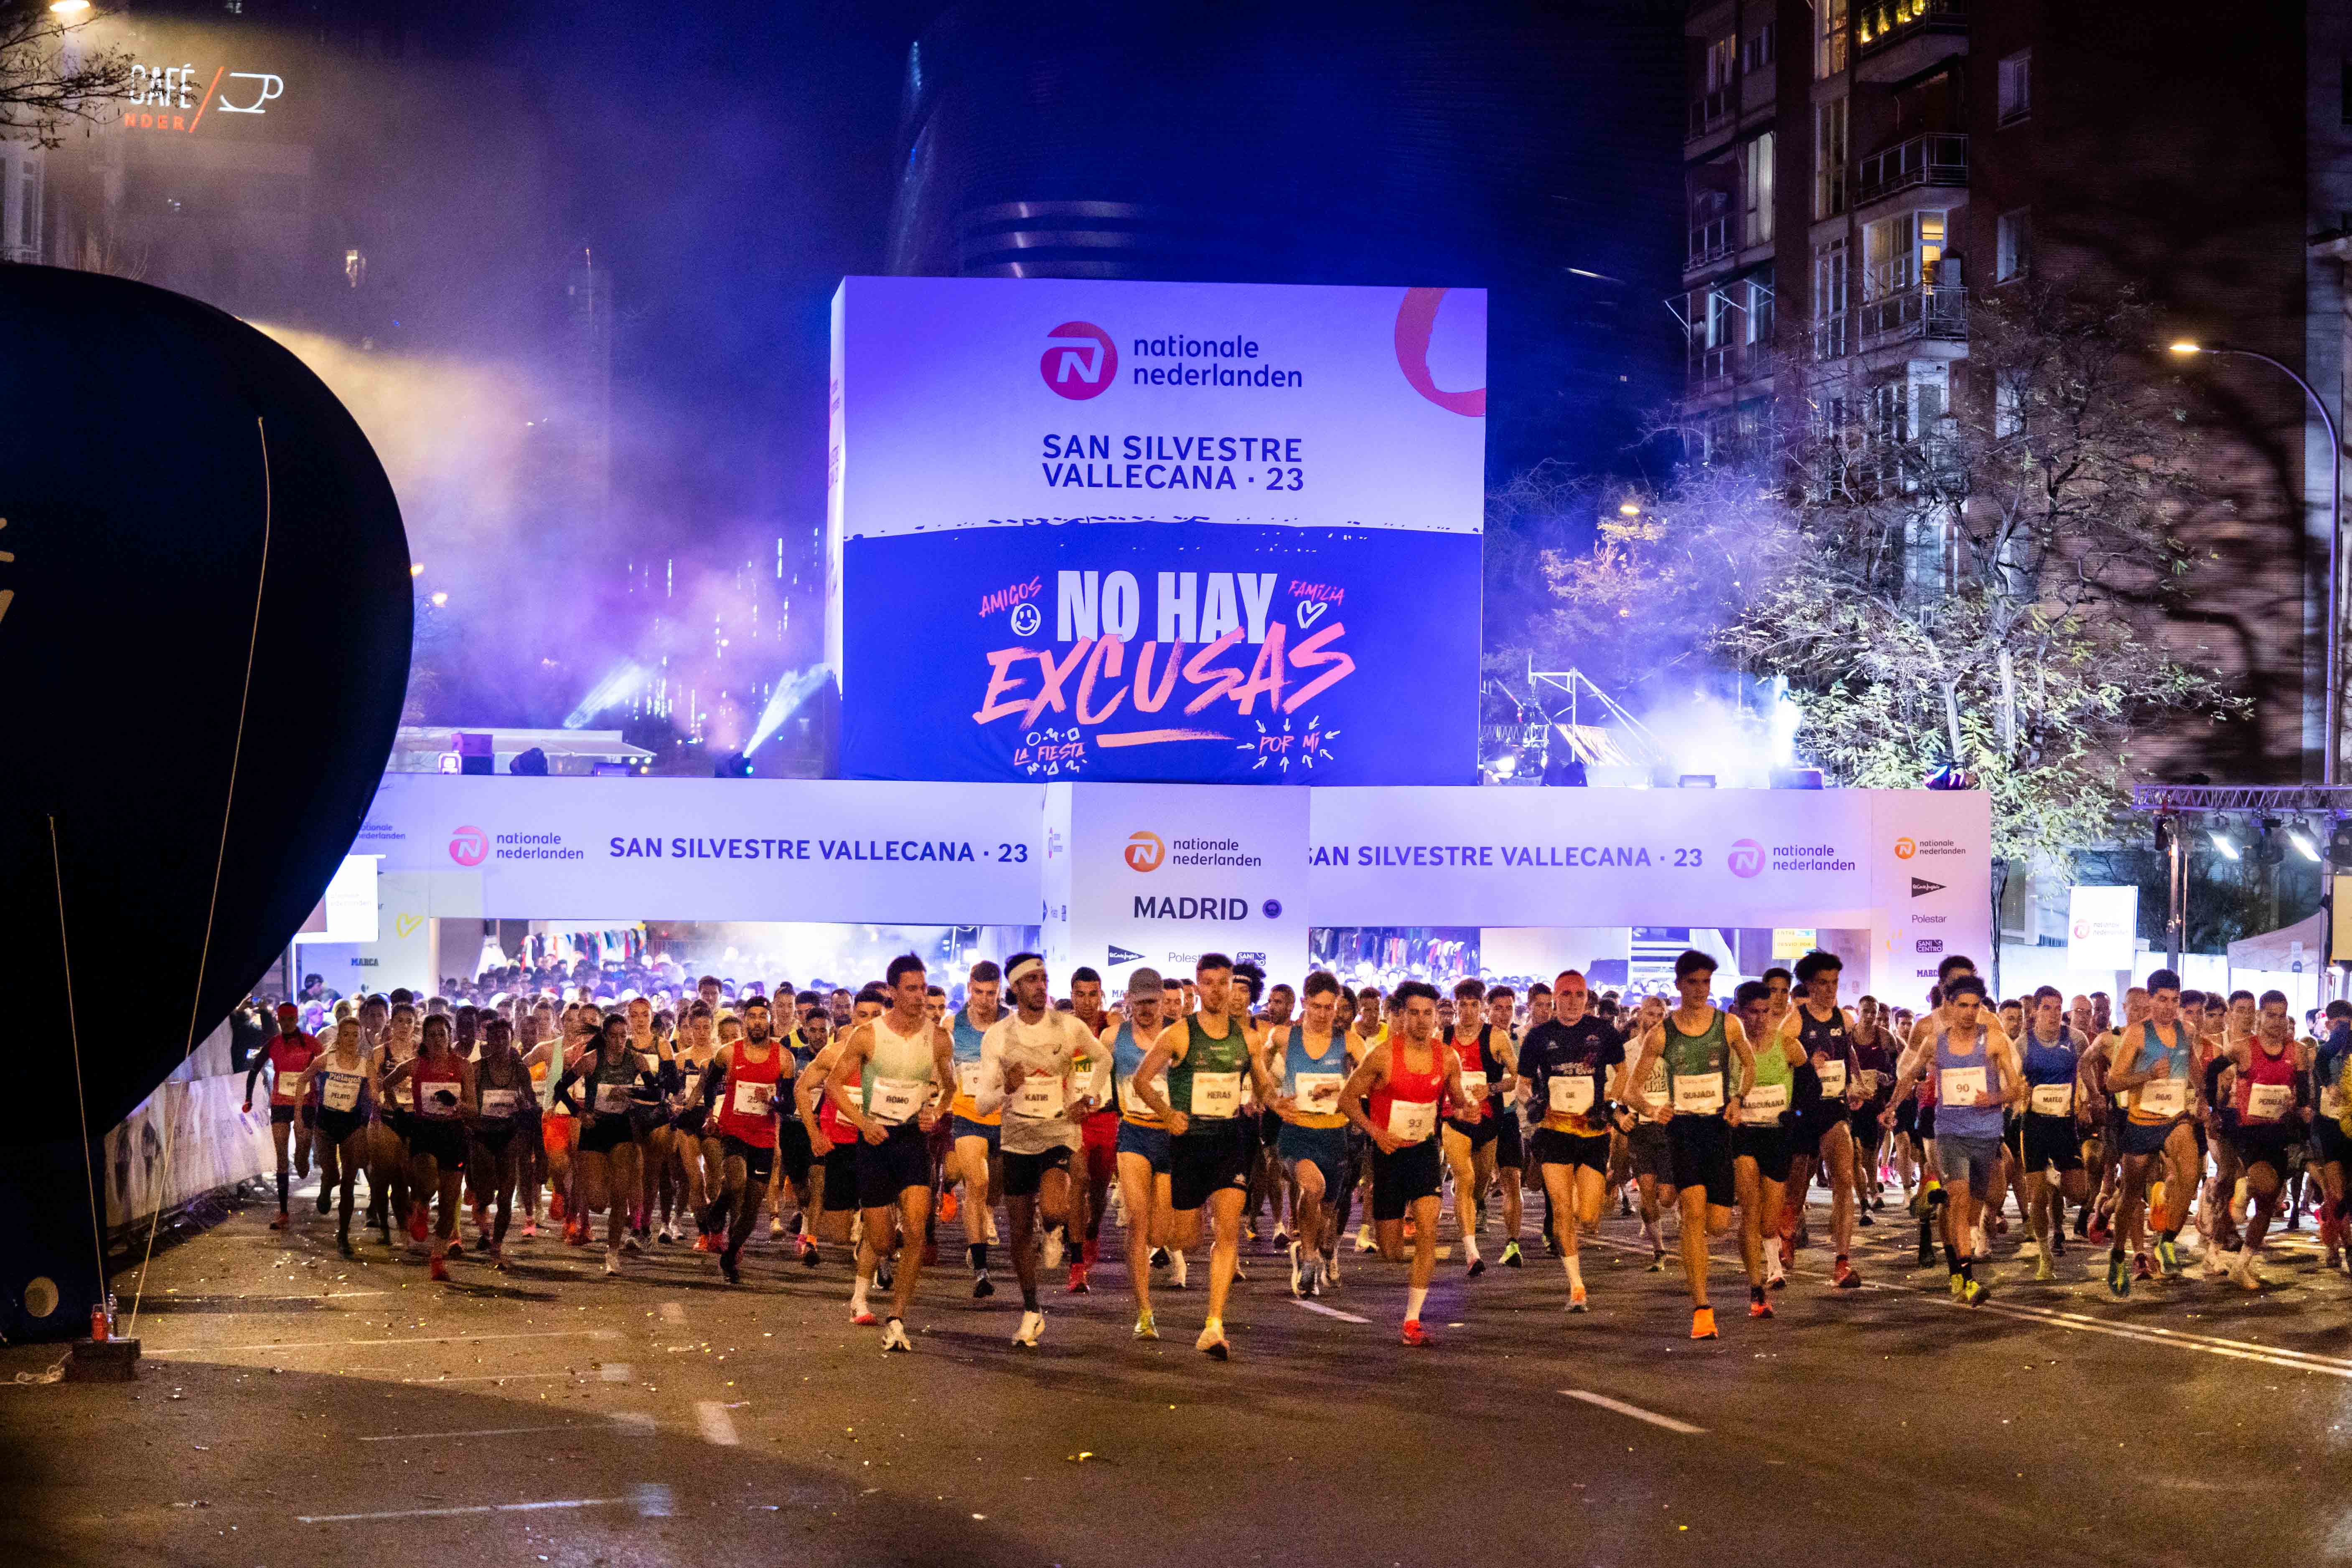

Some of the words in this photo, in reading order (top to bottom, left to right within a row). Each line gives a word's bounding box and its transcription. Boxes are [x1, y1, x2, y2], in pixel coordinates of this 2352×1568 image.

[129, 63, 195, 109] CAFÉ
[1134, 335, 1259, 358] nationale
[1134, 363, 1302, 388] nederlanden
[1043, 434, 1109, 459] SAN
[1123, 435, 1302, 462] SILVESTRE
[1042, 463, 1236, 489] VALLECANA
[1266, 468, 1304, 491] 23
[979, 575, 1043, 618] AMIGOS
[1057, 570, 1139, 642] NO
[1158, 572, 1277, 644] HAY
[972, 621, 1356, 730] EXCUSAS
[1259, 735, 1294, 756] POR
[1014, 748, 1032, 766] LA
[1038, 742, 1087, 762] FIESTA
[360, 823, 393, 831] ationale
[497, 832, 561, 844] nationale
[1173, 838, 1239, 851] nationale
[497, 847, 584, 859] nederlanden
[610, 837, 662, 857] SAN
[671, 838, 810, 859] SILVESTRE
[819, 840, 975, 862] VALLECANA
[998, 843, 1028, 863] 23
[1358, 846, 1493, 866] SILVESTRE
[1501, 847, 1651, 867] VALLECANA
[1674, 848, 1702, 867] 23
[1773, 844, 1834, 856] nationale
[1173, 853, 1261, 867] nederlanden
[1773, 859, 1855, 871] nederlanden
[1134, 896, 1248, 920] MADRID
[1912, 915, 1947, 923] Polestar
[351, 958, 379, 966] MARCA
[1169, 952, 1201, 963] Polest
[1682, 1090, 1716, 1099] QUIJADA
[1956, 1083, 1970, 1093] 90
[886, 1095, 909, 1104] ROMO
[1025, 1093, 1048, 1102] KATIR
[1207, 1091, 1231, 1099] HERAS
[1408, 1119, 1423, 1128] 93
